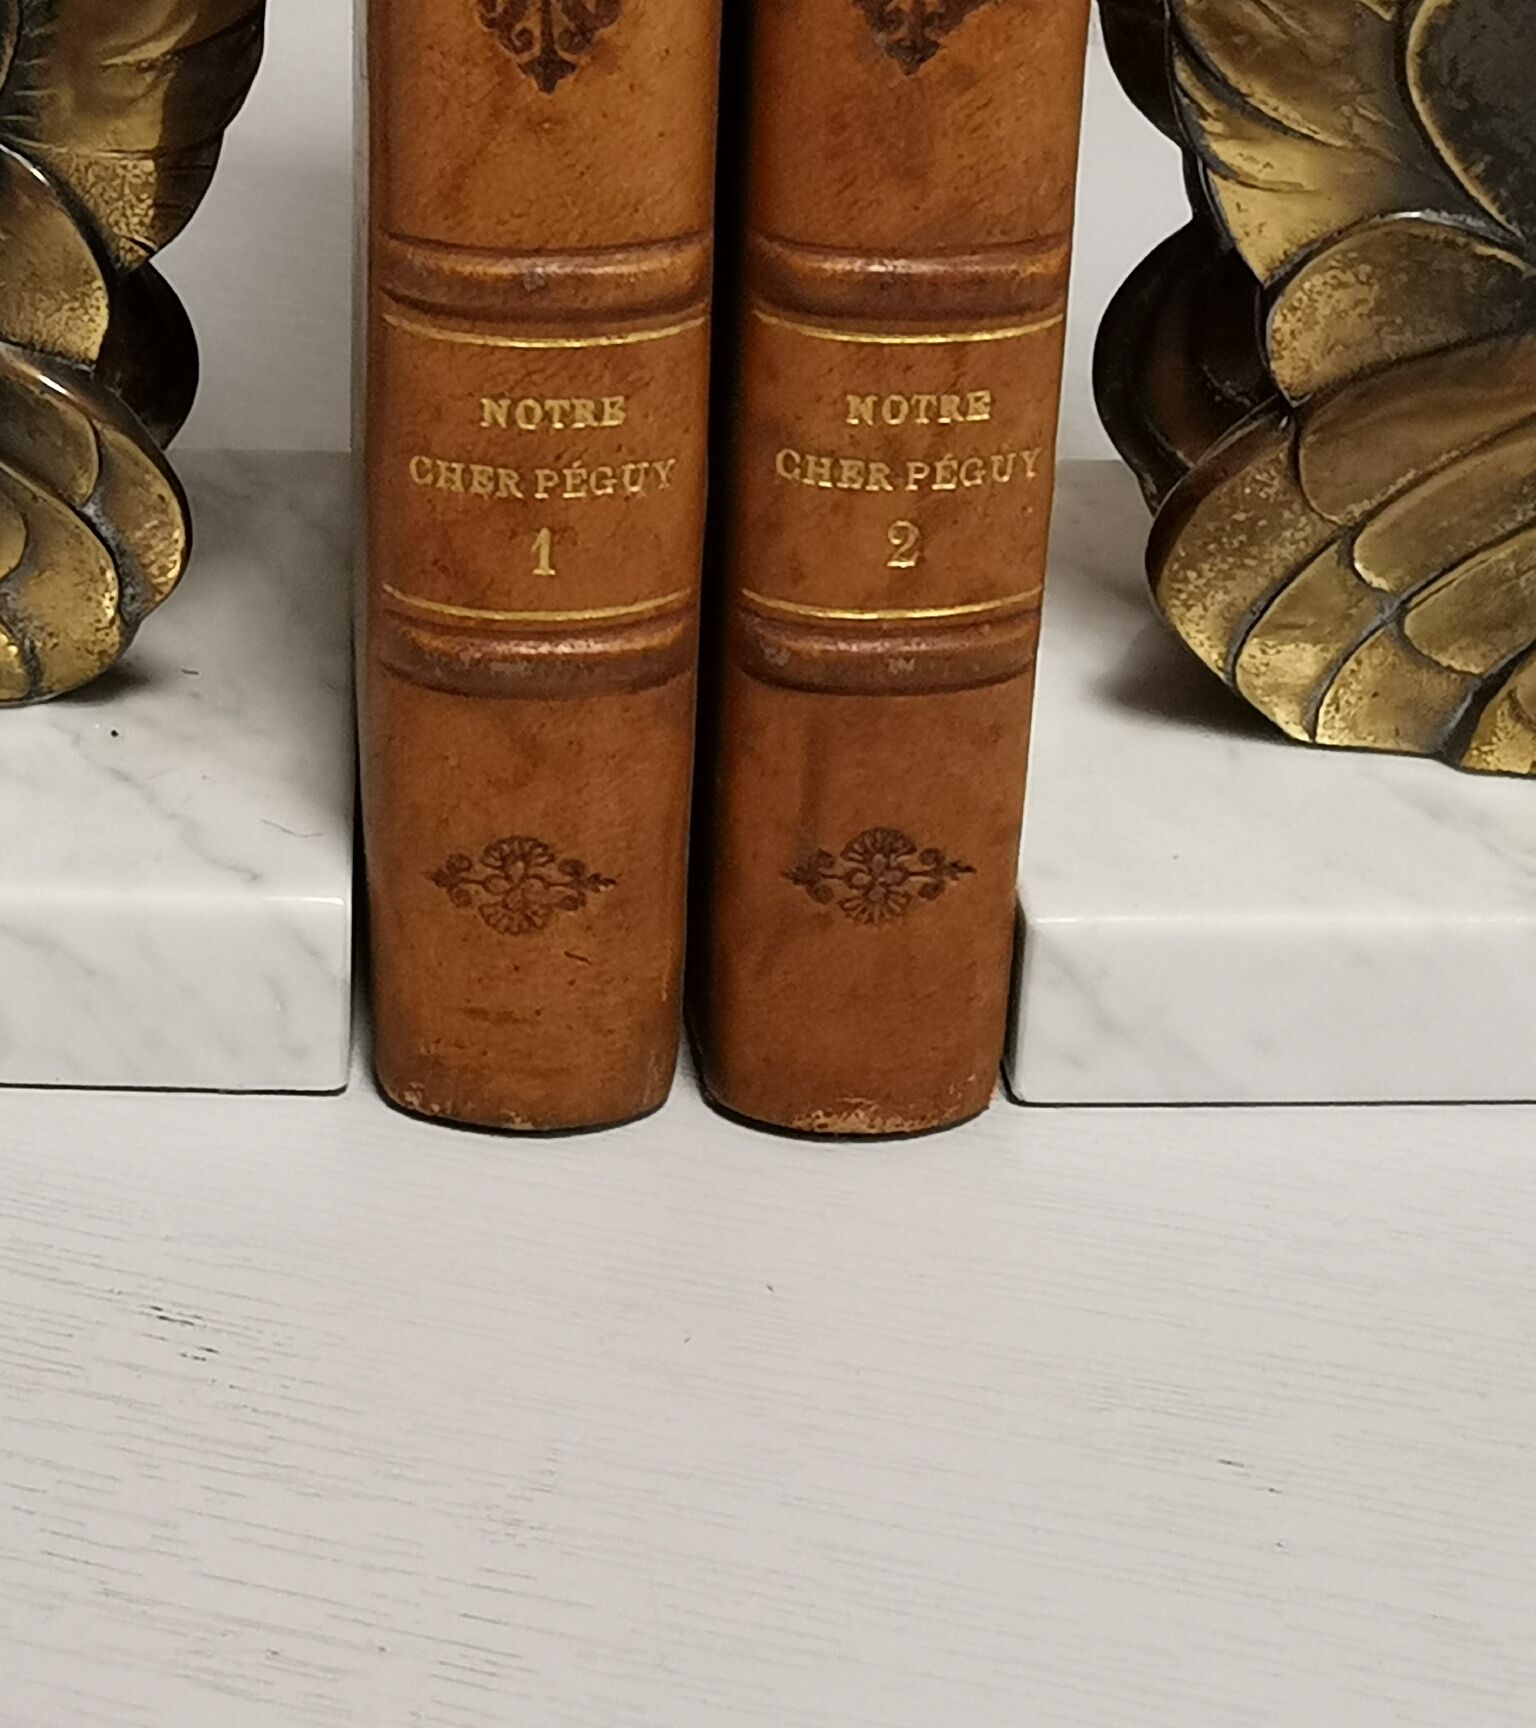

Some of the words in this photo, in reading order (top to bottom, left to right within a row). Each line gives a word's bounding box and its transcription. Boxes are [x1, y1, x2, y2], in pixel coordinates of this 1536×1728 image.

[480, 395, 628, 429] NOTRE
[846, 390, 992, 426] NOTRE
[409, 455, 524, 499] CHER
[534, 459, 677, 499] PÉGUY
[775, 448, 894, 491] CHER
[905, 449, 1041, 491] PÉGUY
[531, 527, 556, 576] 1
[887, 521, 920, 568] 2
